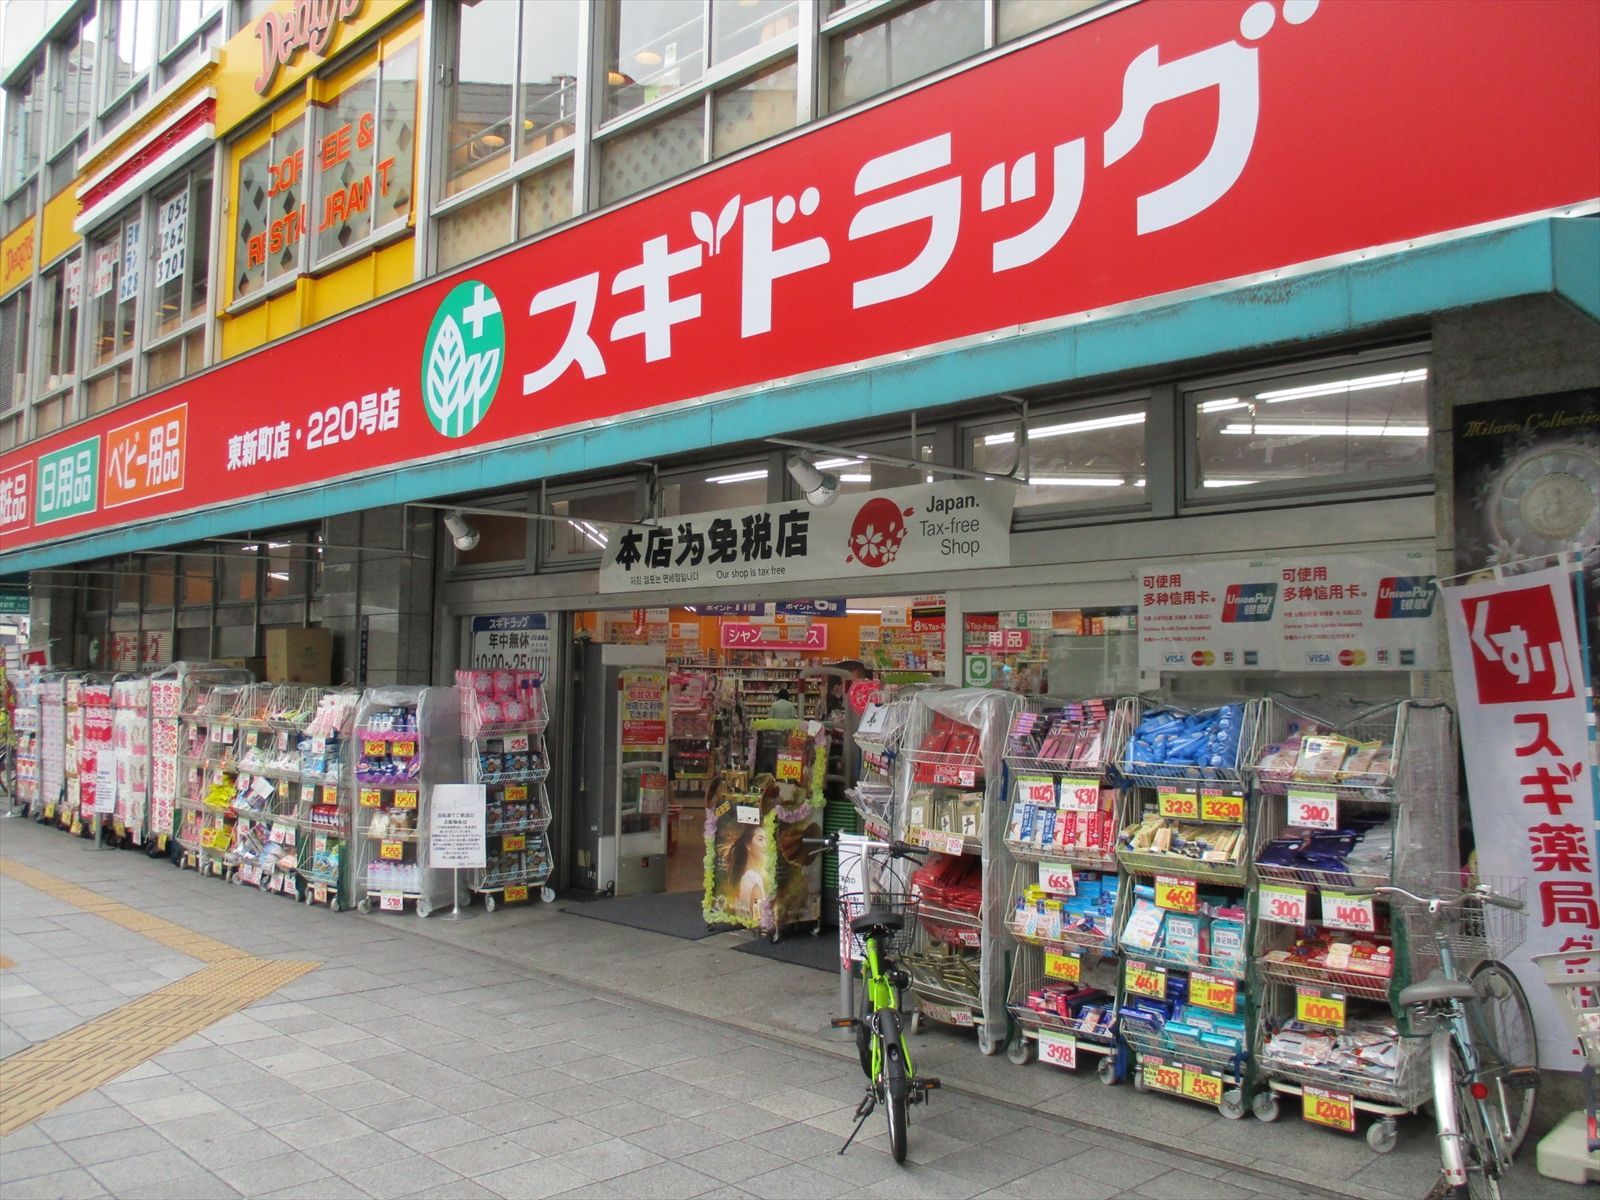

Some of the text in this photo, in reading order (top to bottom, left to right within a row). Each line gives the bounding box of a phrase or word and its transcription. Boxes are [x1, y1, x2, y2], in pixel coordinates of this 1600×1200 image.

[267, 112, 374, 198] COFEE &
[523, 0, 1321, 396] スギドラッグ
[247, 157, 395, 270] RESTAURANT
[163, 223, 183, 251] 262
[157, 248, 185, 283] 3701
[227, 387, 400, 471] 東新町店・220号店
[1463, 408, 1600, 438] Milano Collectio
[108, 419, 180, 489] ベビー用品
[41, 449, 92, 513] 日用品
[926, 496, 980, 515] Japan.
[919, 517, 980, 537] Tax-free
[615, 509, 811, 571] 本店为免税店
[941, 538, 980, 557] Shop
[716, 564, 786, 580] Our shop is tax free
[1143, 574, 1182, 589] 可使用
[1282, 566, 1328, 583] 可使用
[1143, 590, 1217, 607] 多种信用卡。
[1226, 593, 1275, 606] UnionPay
[1283, 584, 1368, 602] 多种信用卡。
[1380, 586, 1434, 600] UnionPay
[489, 615, 530, 629] スギドラッグ
[489, 632, 530, 649] 年中無休
[1472, 601, 1570, 695] くすり
[1164, 654, 1185, 663] VISA
[1308, 653, 1330, 663] VISA
[783, 765, 798, 776] 500
[1300, 804, 1330, 821] 300
[1048, 875, 1071, 890] 665
[1270, 899, 1301, 917] 300
[1336, 905, 1369, 924] 400
[1135, 974, 1159, 991] 461
[1304, 1002, 1339, 1019] 1000
[1047, 1043, 1072, 1063] 398
[1192, 1077, 1218, 1098] 553
[1315, 1100, 1347, 1120] 1200
